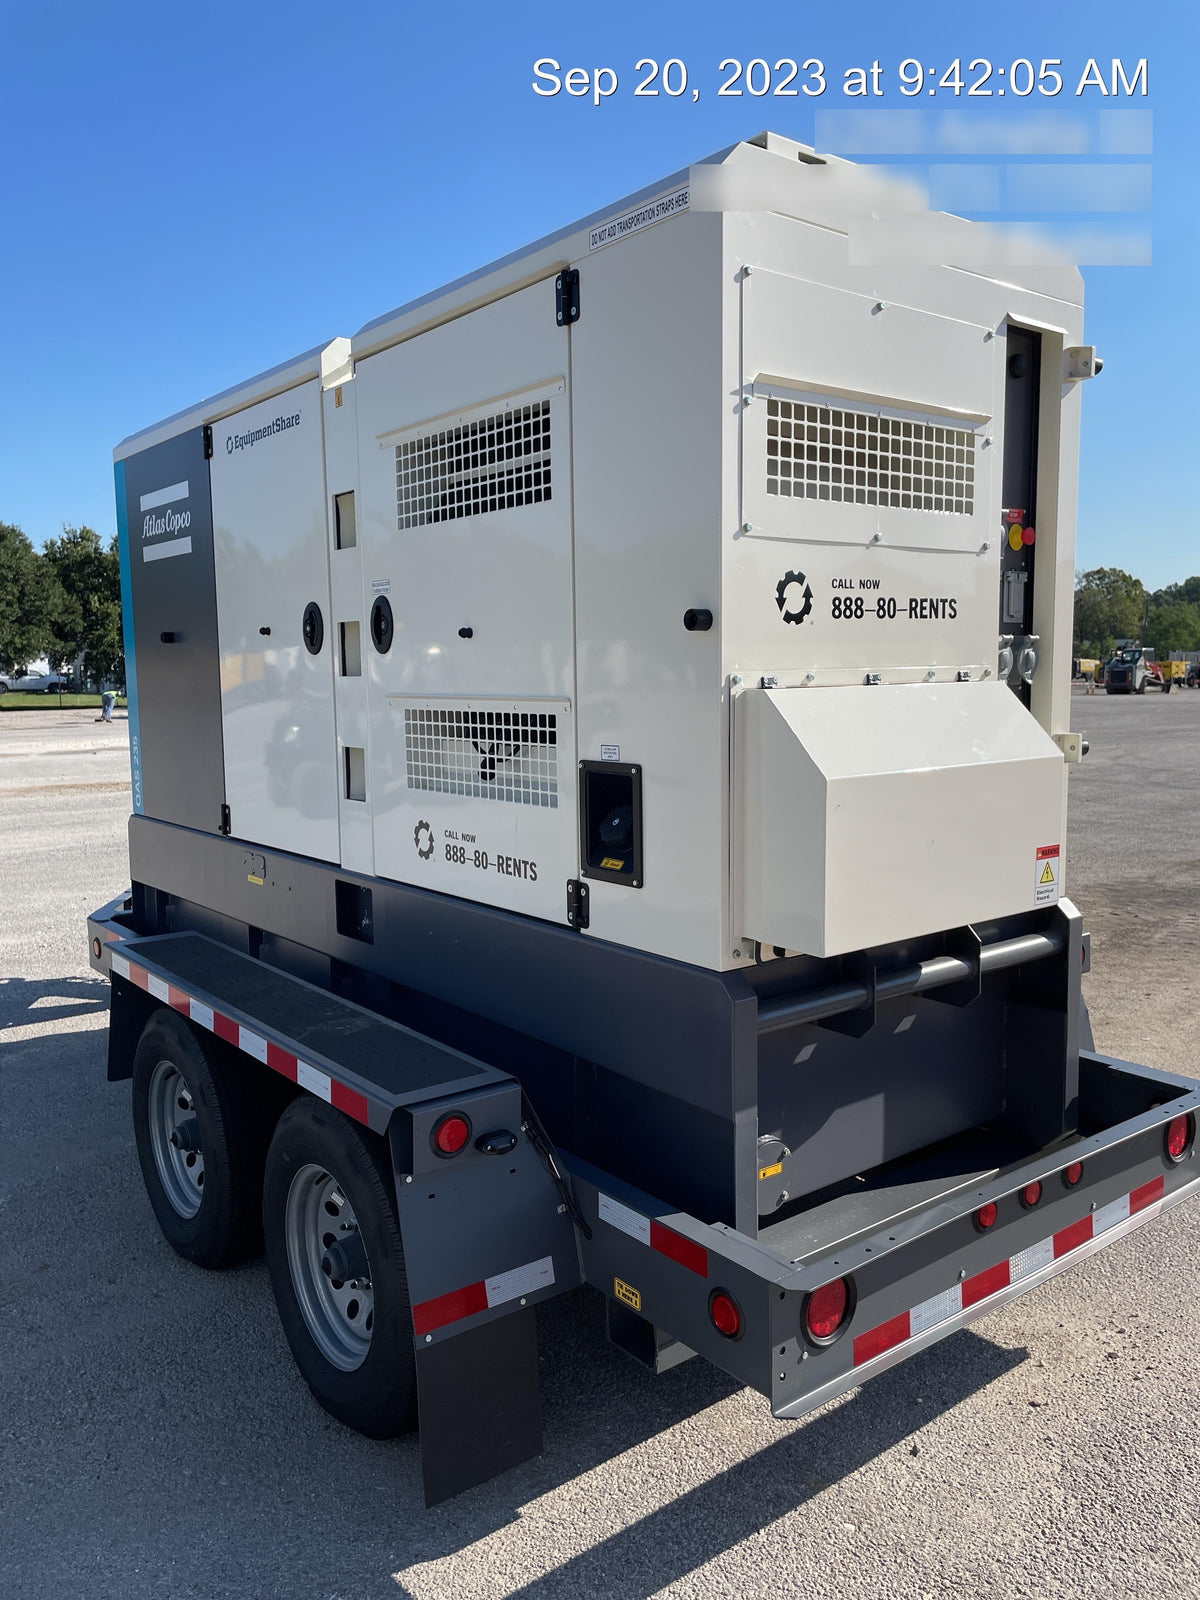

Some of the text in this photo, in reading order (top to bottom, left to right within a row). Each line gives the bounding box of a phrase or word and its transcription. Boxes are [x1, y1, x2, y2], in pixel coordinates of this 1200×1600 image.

[591, 191, 688, 246] DO NOT ADD TRANSPORTATION STRAPS HERE
[234, 413, 301, 451] EquipmentShare
[141, 509, 191, 539] Atlas Copco
[831, 578, 881, 591] CALL NOW
[444, 829, 477, 844] CALL NOW
